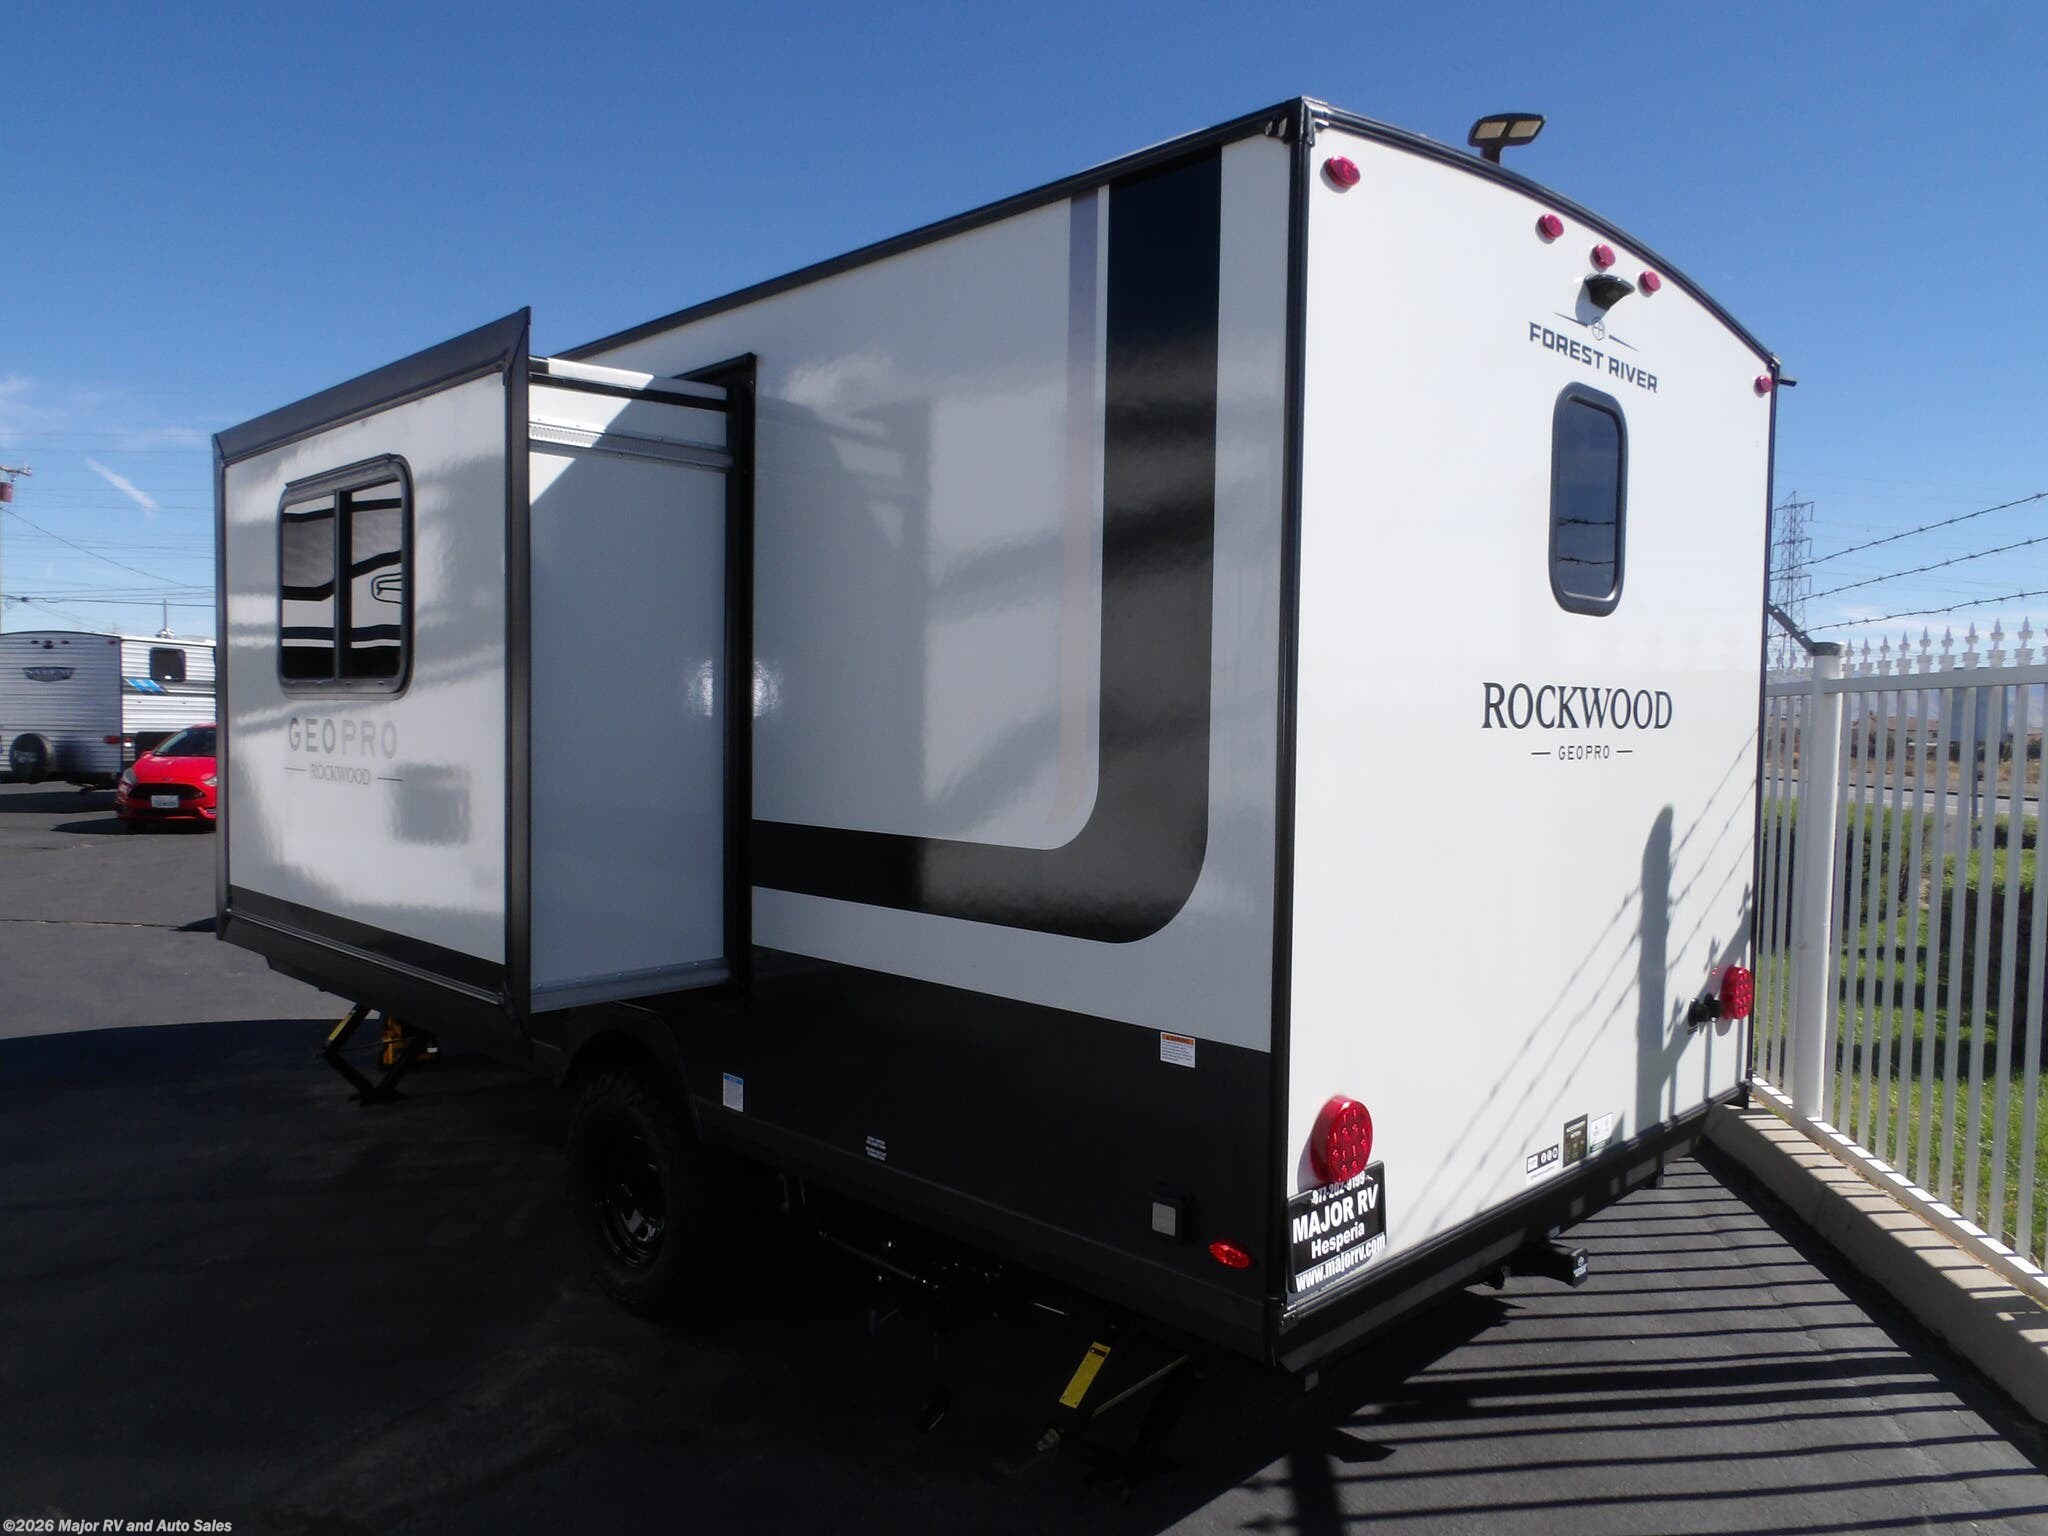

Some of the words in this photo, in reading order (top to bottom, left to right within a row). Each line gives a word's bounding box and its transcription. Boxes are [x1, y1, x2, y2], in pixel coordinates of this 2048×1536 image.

[1529, 321, 1604, 369] FOREST
[1608, 355, 1658, 393] RIVER
[1482, 682, 1673, 729] ROCKWOOD
[311, 763, 371, 785] ROCKWOOD
[1558, 745, 1611, 760] GEOPRO
[1292, 1196, 1355, 1244] MAJOR
[1357, 1184, 1379, 1216] RV
[1296, 1234, 1386, 1293] www.majorrv.com
[1311, 1221, 1365, 1259] Hesperia
